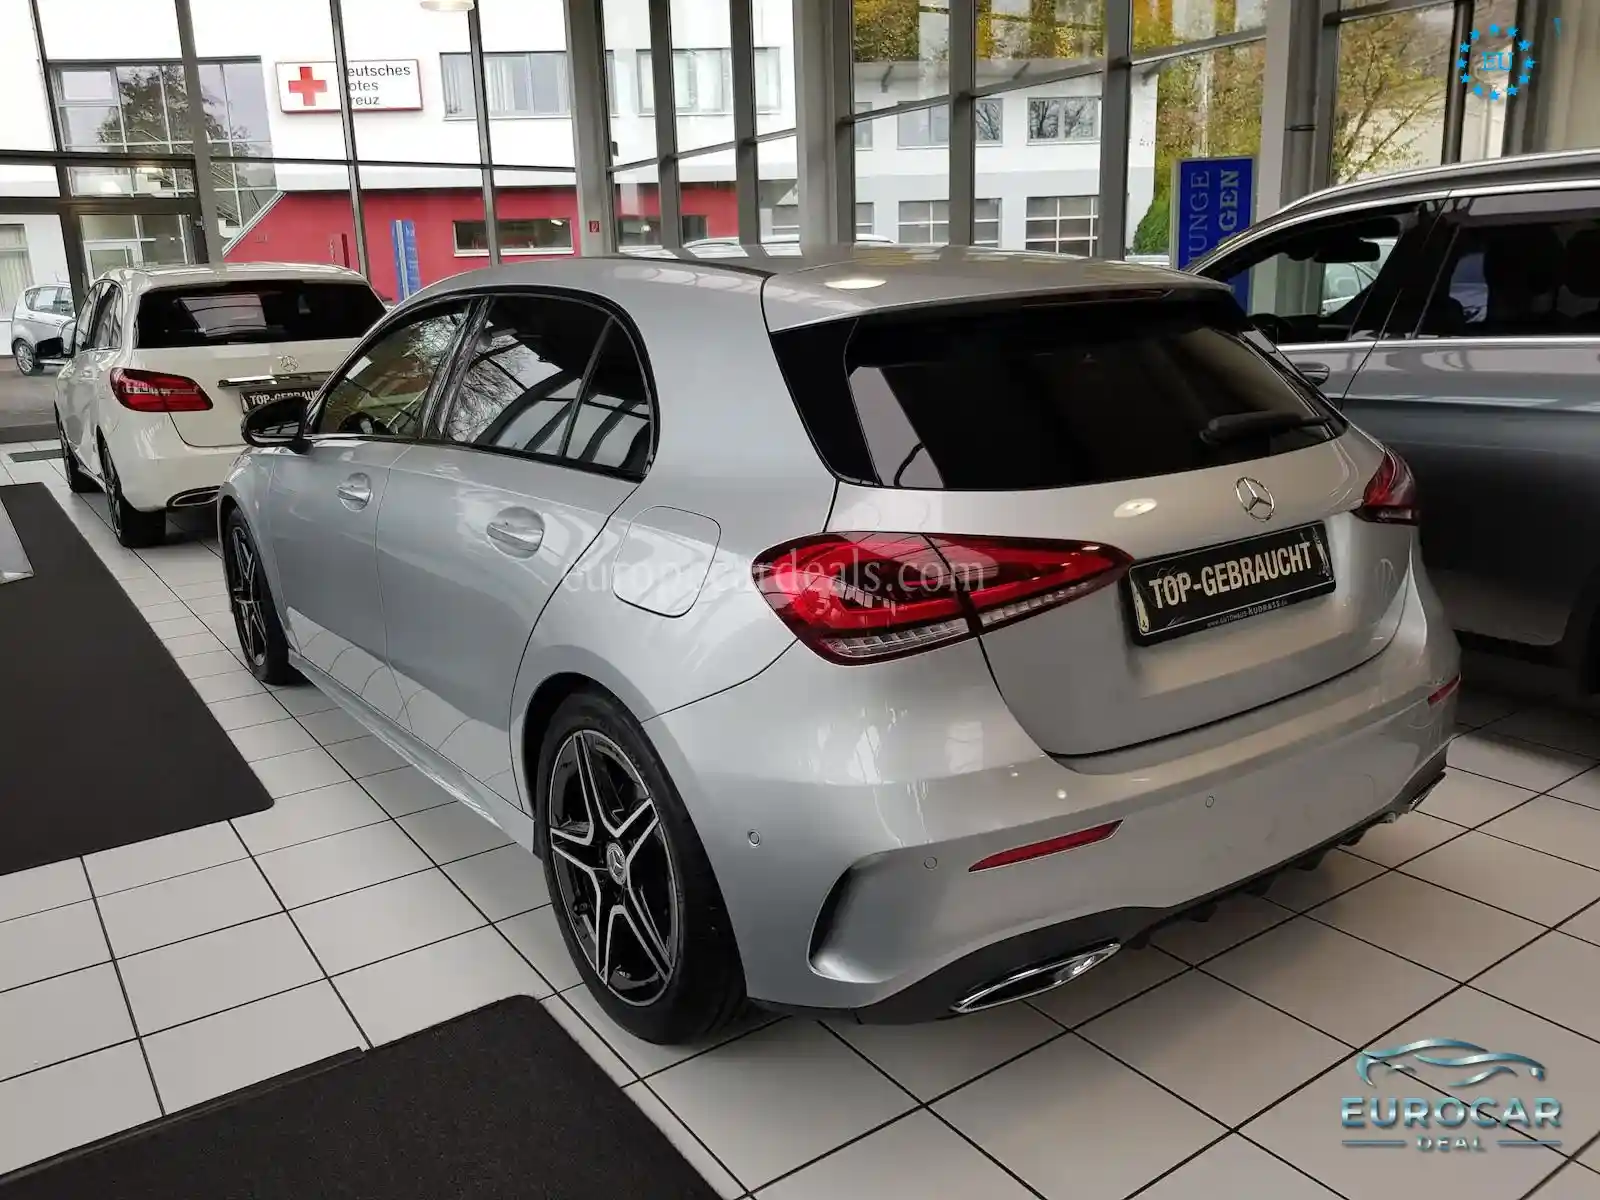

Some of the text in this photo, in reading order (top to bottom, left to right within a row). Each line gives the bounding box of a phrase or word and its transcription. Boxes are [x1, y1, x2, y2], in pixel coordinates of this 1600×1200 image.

[347, 64, 411, 77] eutsches
[349, 80, 379, 91] otes
[351, 95, 380, 105] reuz
[1149, 541, 1311, 609] TOP-GEBRAUCHT
